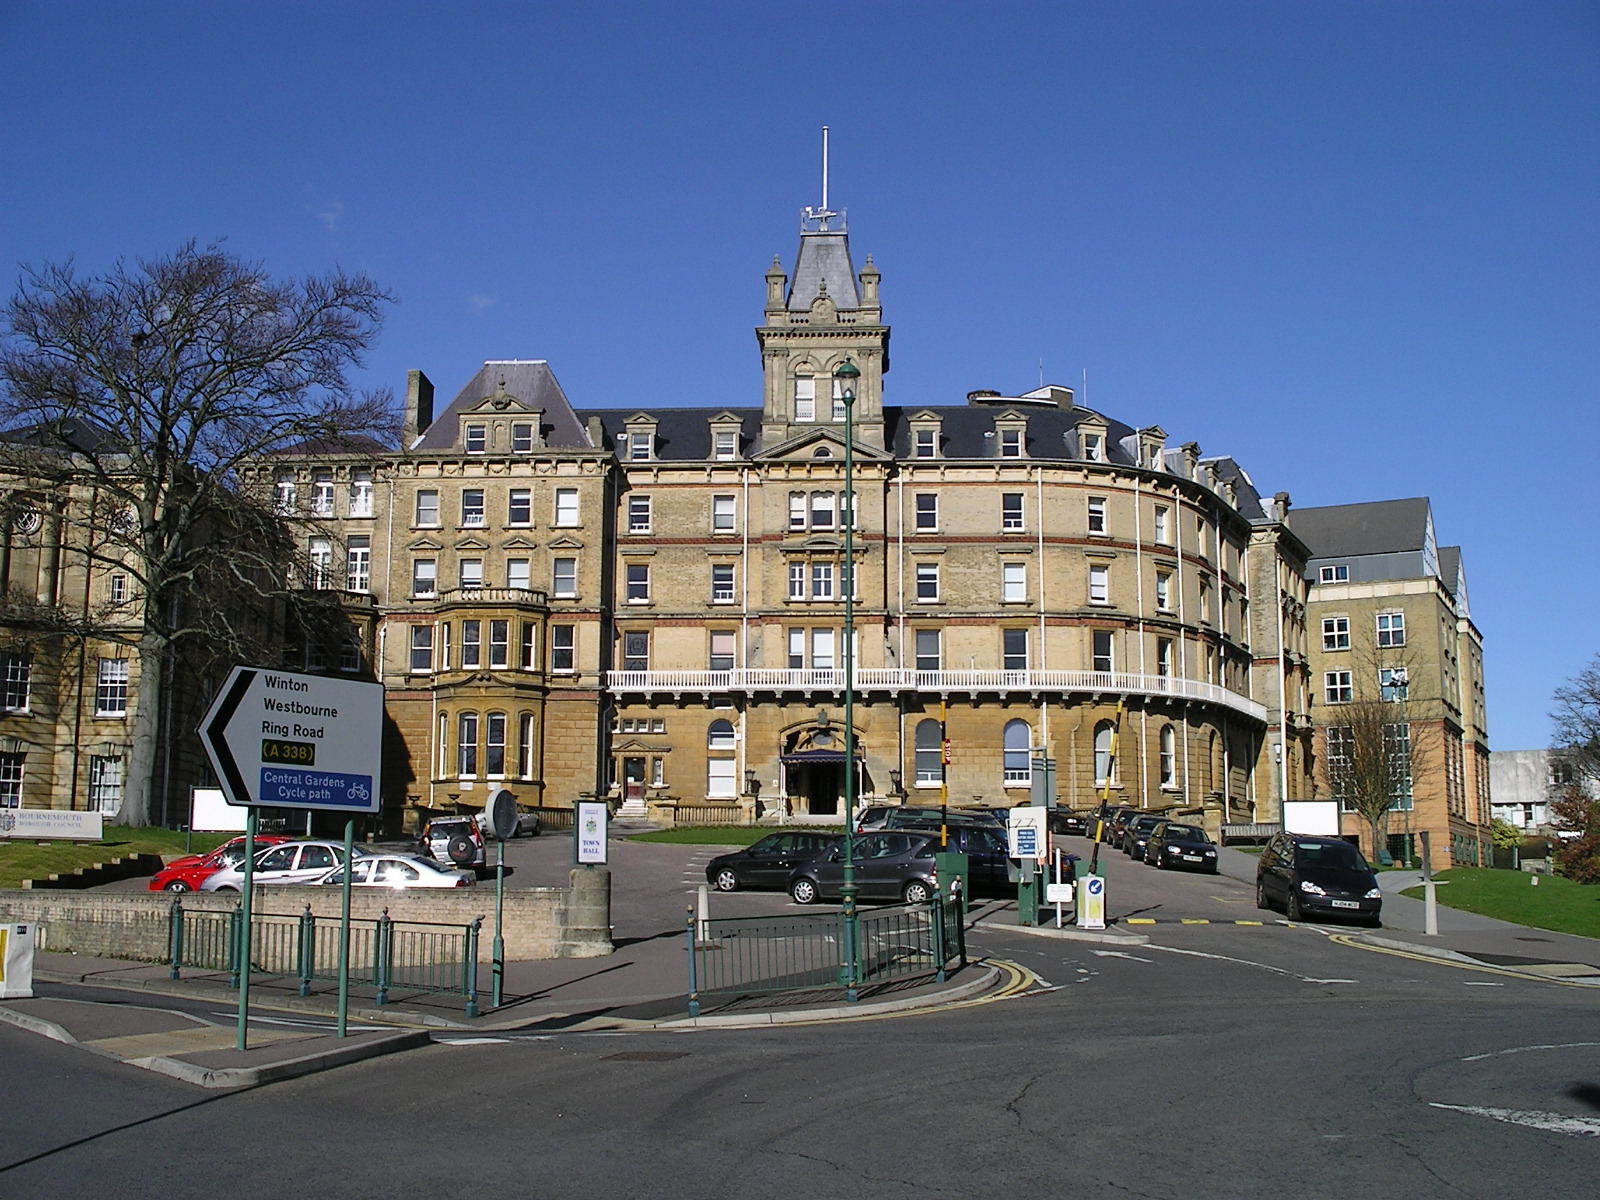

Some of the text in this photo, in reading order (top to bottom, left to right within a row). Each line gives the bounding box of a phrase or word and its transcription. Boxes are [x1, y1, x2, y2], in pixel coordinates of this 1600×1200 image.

[264, 675, 308, 692] Winton
[263, 697, 338, 718] Westbourne
[262, 720, 324, 739] Ring Road
[264, 771, 345, 788] Central Gardens
[278, 786, 331, 801] Cycle path
[19, 813, 82, 821] BOURNEMOUTH
